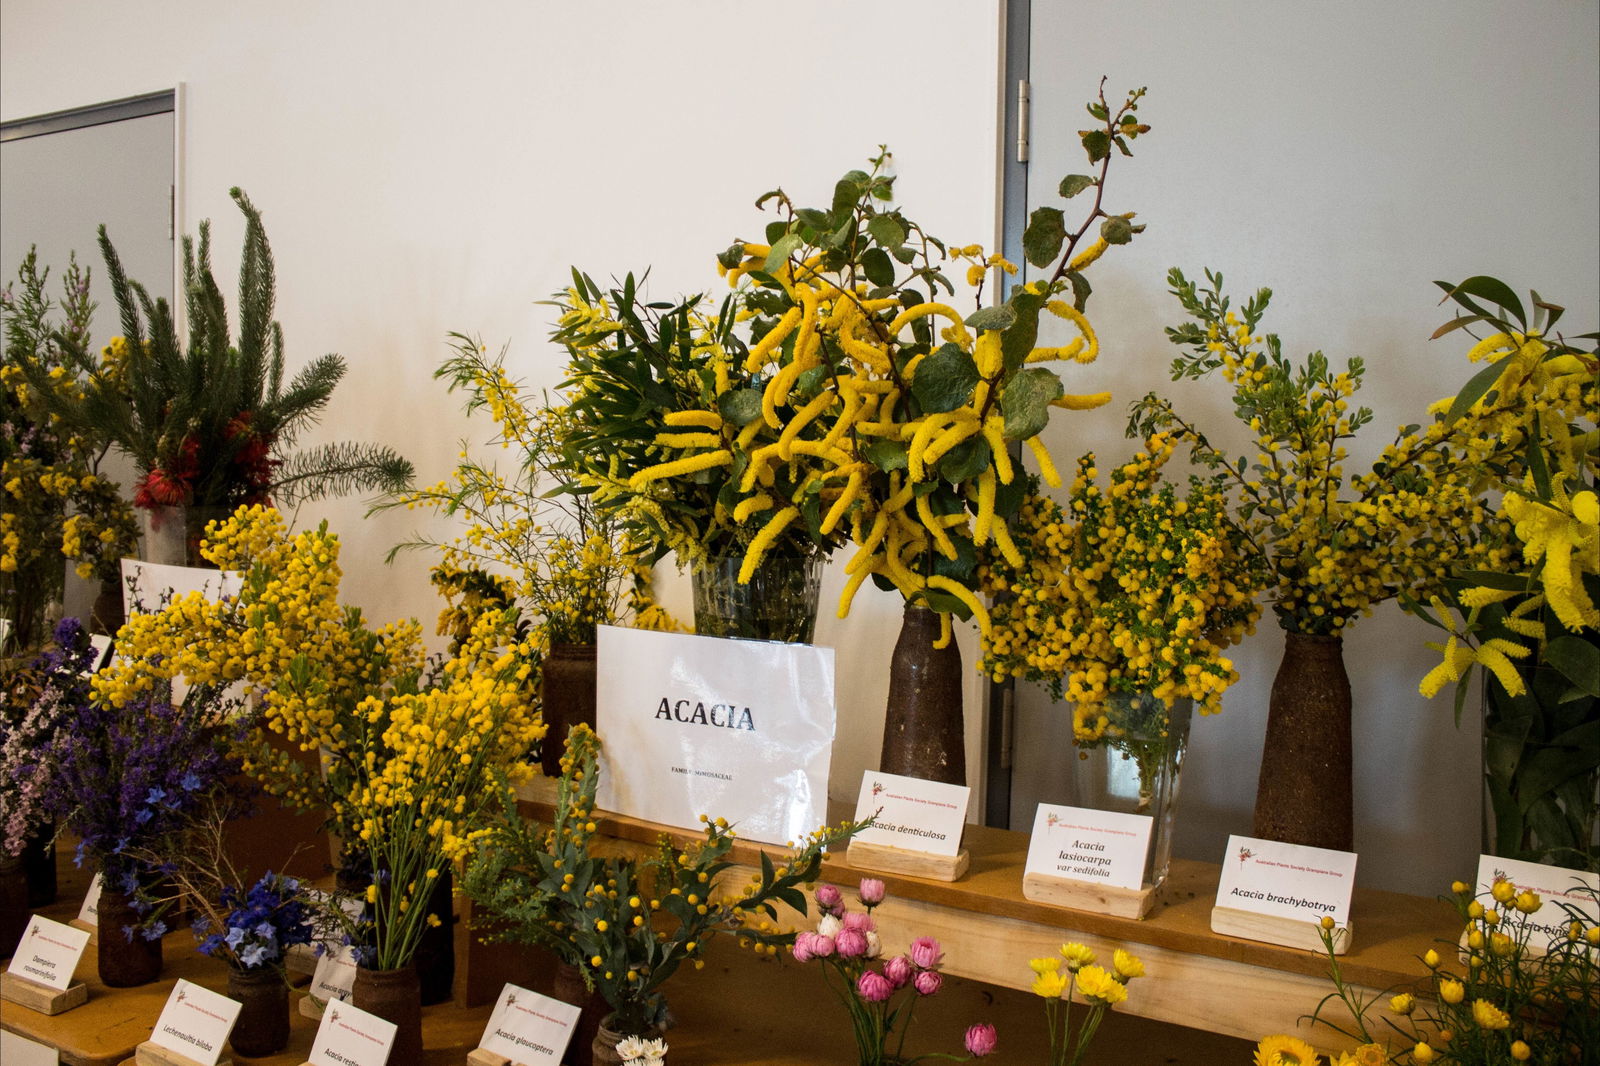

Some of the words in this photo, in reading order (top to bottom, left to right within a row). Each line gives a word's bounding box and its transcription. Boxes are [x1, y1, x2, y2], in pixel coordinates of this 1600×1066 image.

[655, 697, 756, 731] ACACIA
[897, 825, 947, 841] denticulosa
[1072, 839, 1105, 852] Acacia
[1058, 850, 1112, 866] lasiocarpa
[1056, 864, 1072, 872] var
[1072, 865, 1111, 878] sedifolia
[1231, 887, 1265, 901] Acacia
[1266, 892, 1336, 913] brachybotrya
[319, 982, 338, 993] Acacia
[495, 1028, 516, 1041] Acacia
[515, 1036, 554, 1056] glaucoptera
[324, 1048, 343, 1062] Acacia
